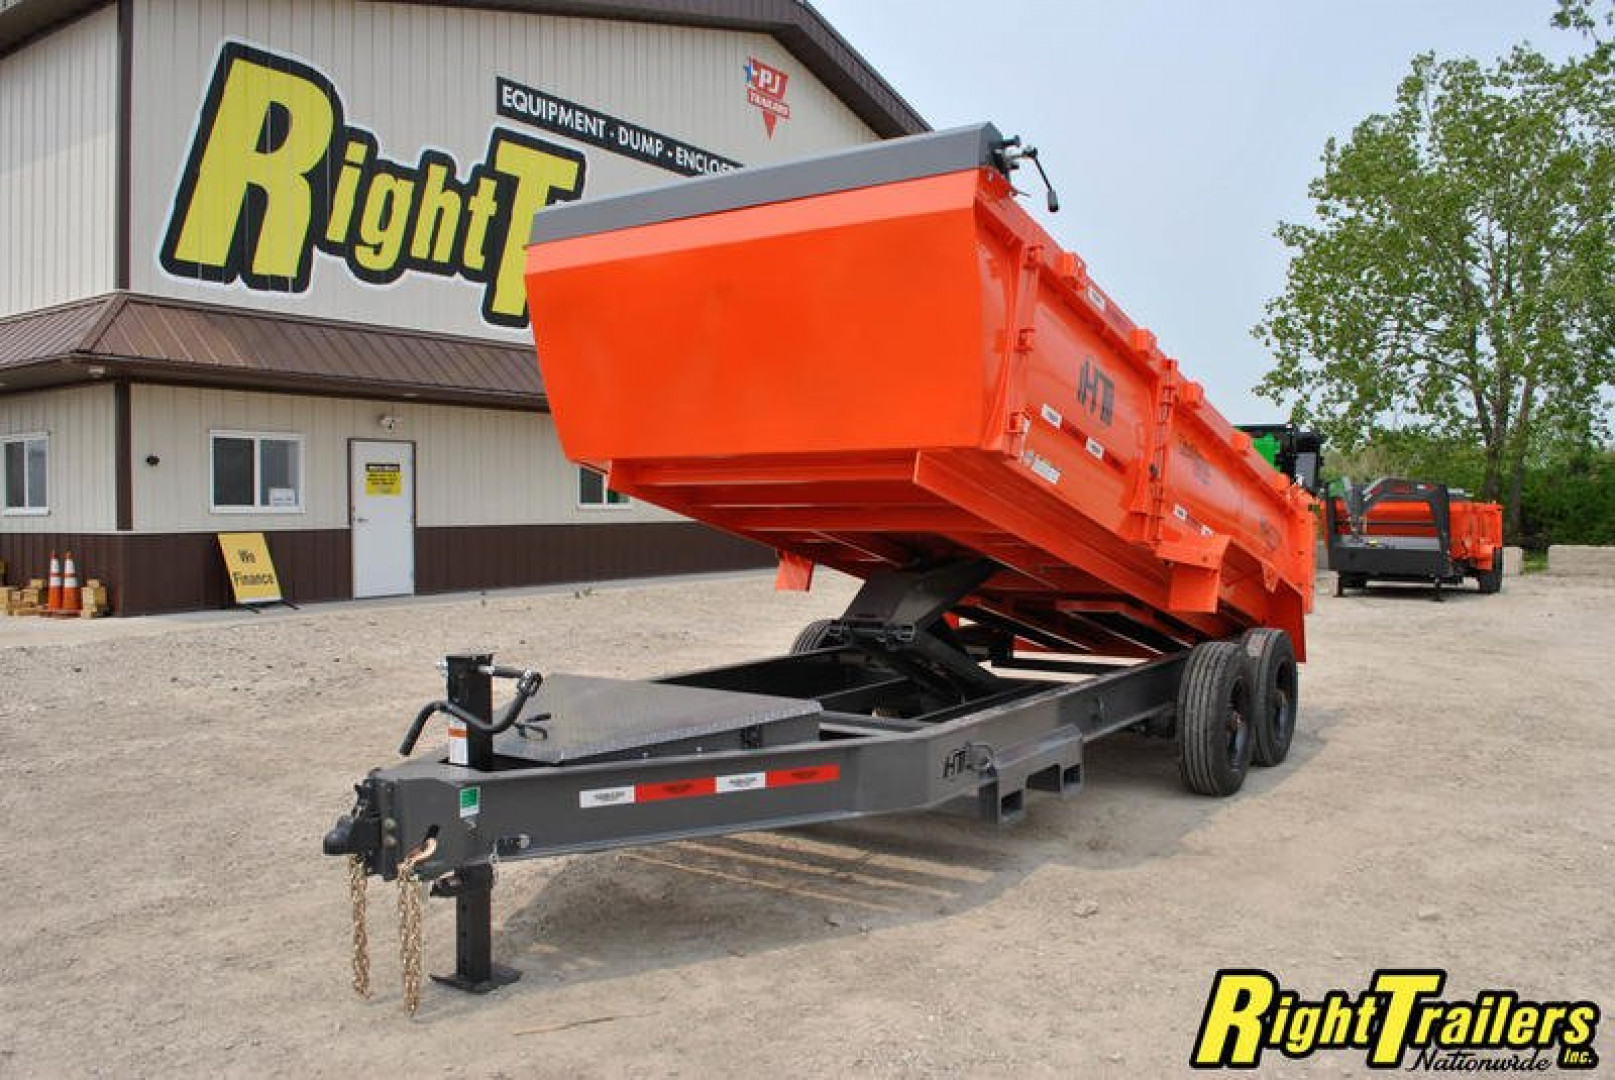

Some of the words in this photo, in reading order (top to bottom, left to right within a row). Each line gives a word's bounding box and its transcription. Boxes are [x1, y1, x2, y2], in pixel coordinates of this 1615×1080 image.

[759, 67, 781, 94] PJ
[502, 85, 607, 138] EQUIPMENT
[618, 126, 663, 158] DUMP
[170, 53, 582, 321] RightT
[237, 549, 256, 564] We
[231, 570, 276, 587] Finance
